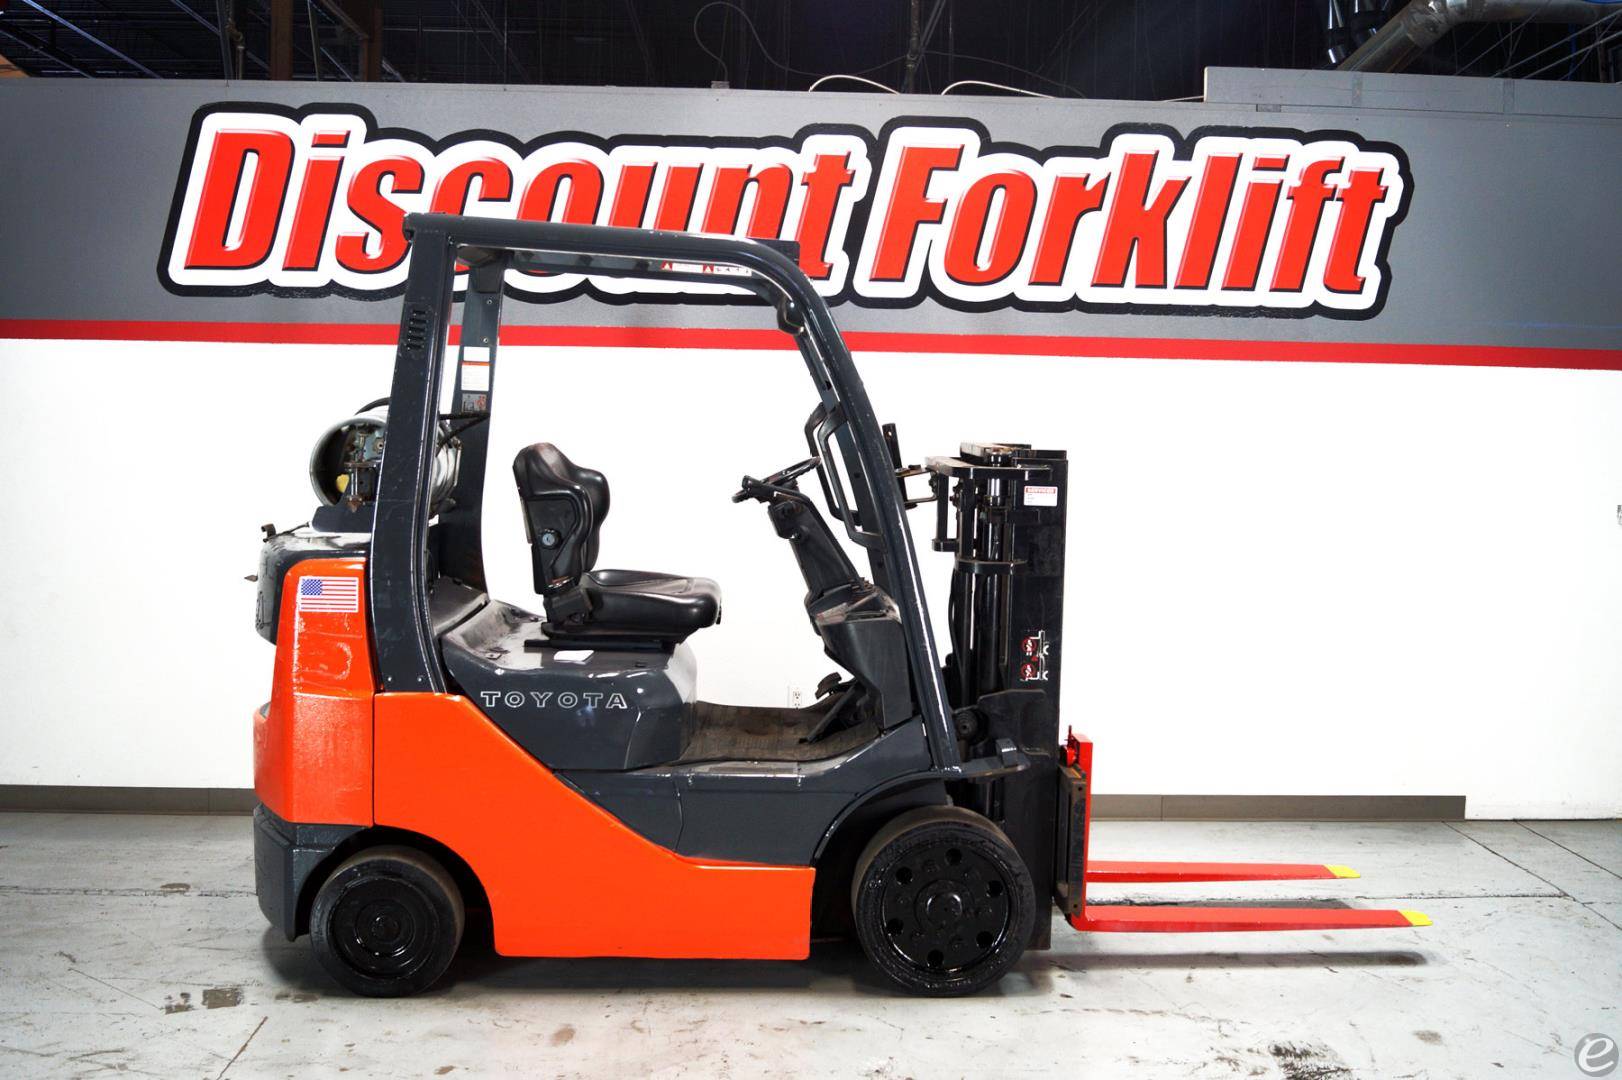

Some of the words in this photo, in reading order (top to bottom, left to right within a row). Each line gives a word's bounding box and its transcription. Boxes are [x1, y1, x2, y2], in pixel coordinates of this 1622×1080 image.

[183, 128, 856, 282] Discount
[869, 143, 1388, 294] Forklift
[480, 691, 628, 709] TOYOTA
